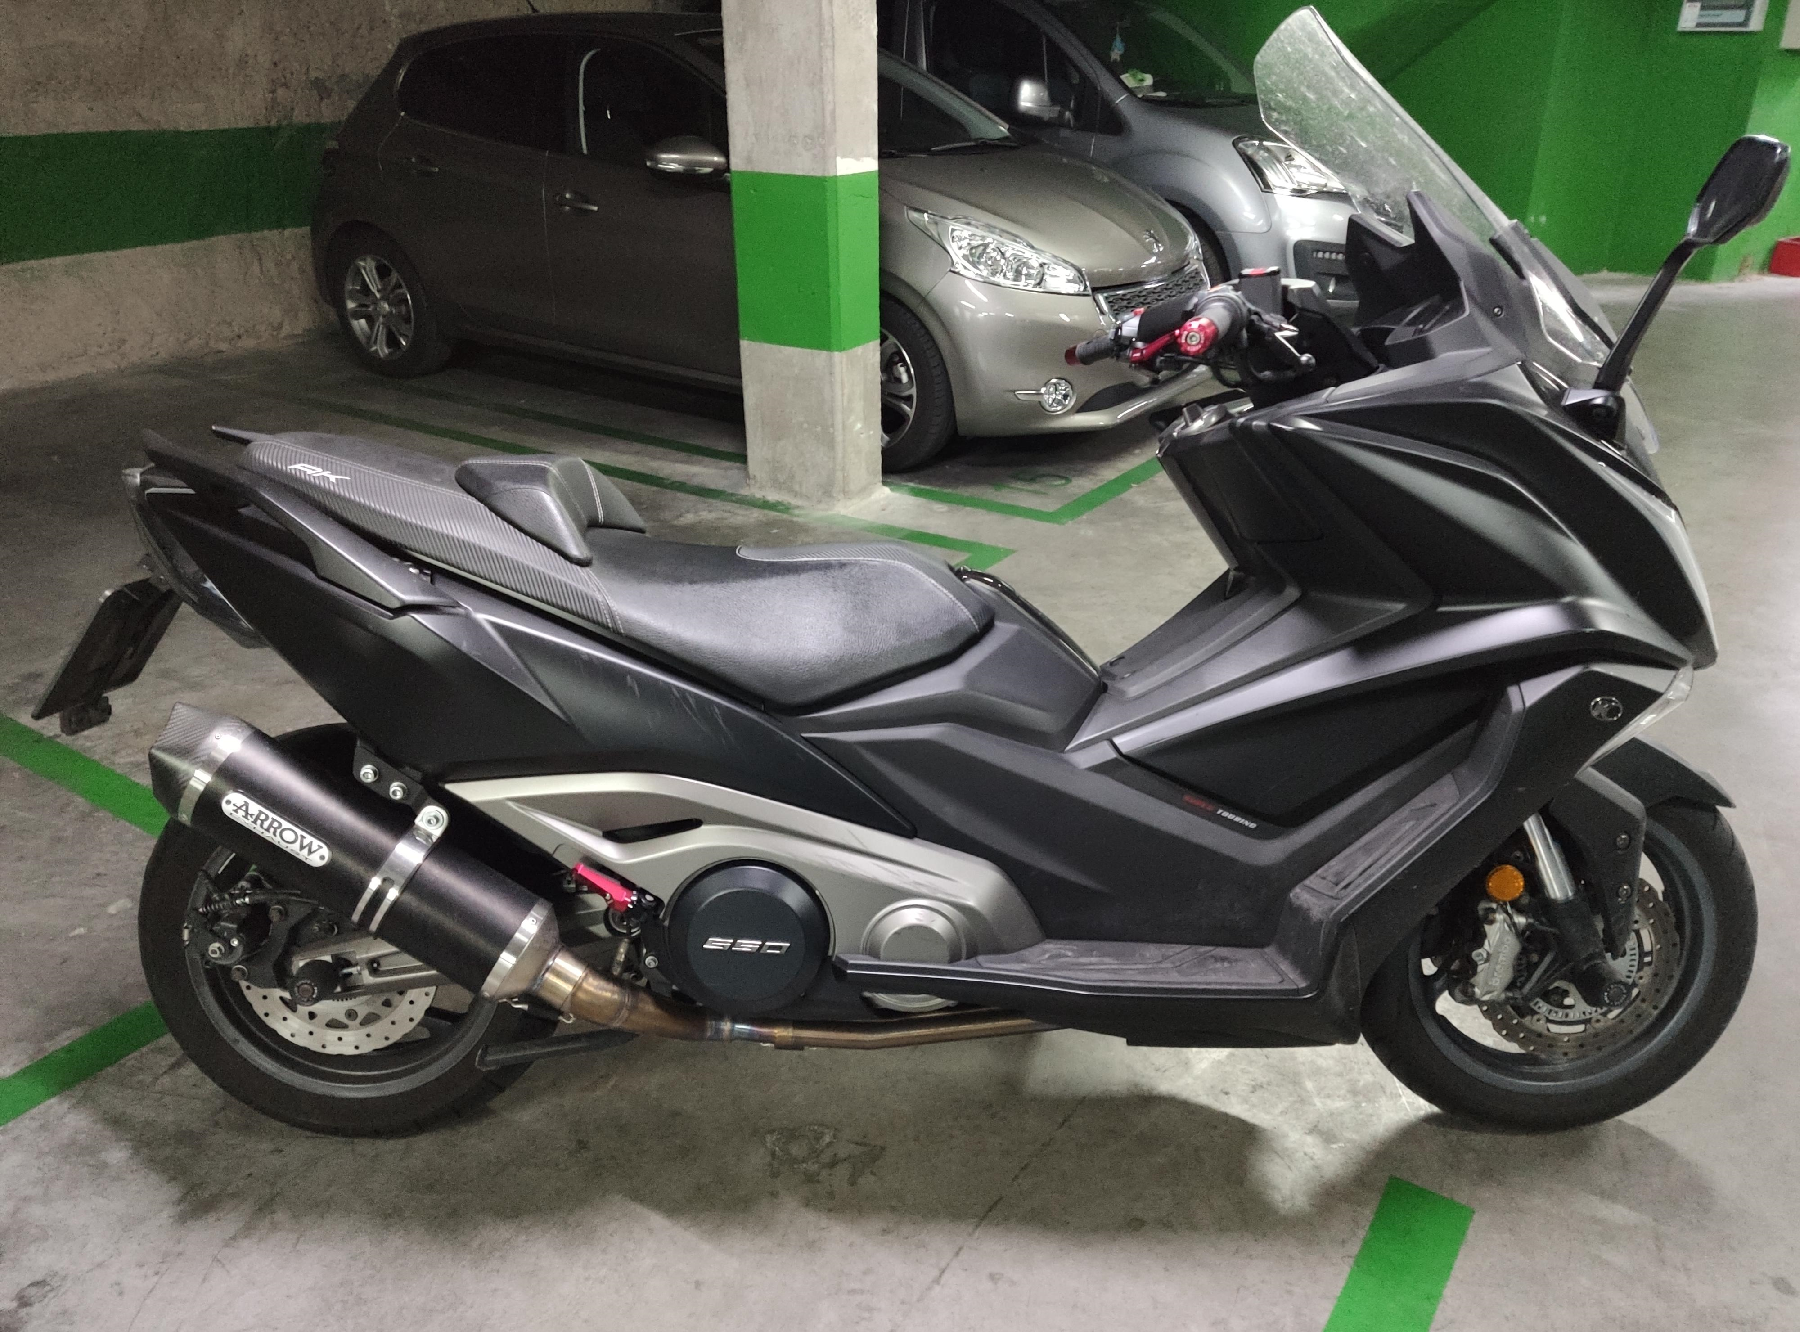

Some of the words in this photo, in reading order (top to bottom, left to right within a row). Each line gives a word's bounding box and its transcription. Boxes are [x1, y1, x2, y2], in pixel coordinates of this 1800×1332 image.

[287, 463, 351, 483] AK
[232, 800, 324, 857] ARROW
[1216, 809, 1257, 829] TOURING
[702, 937, 791, 954] 550
